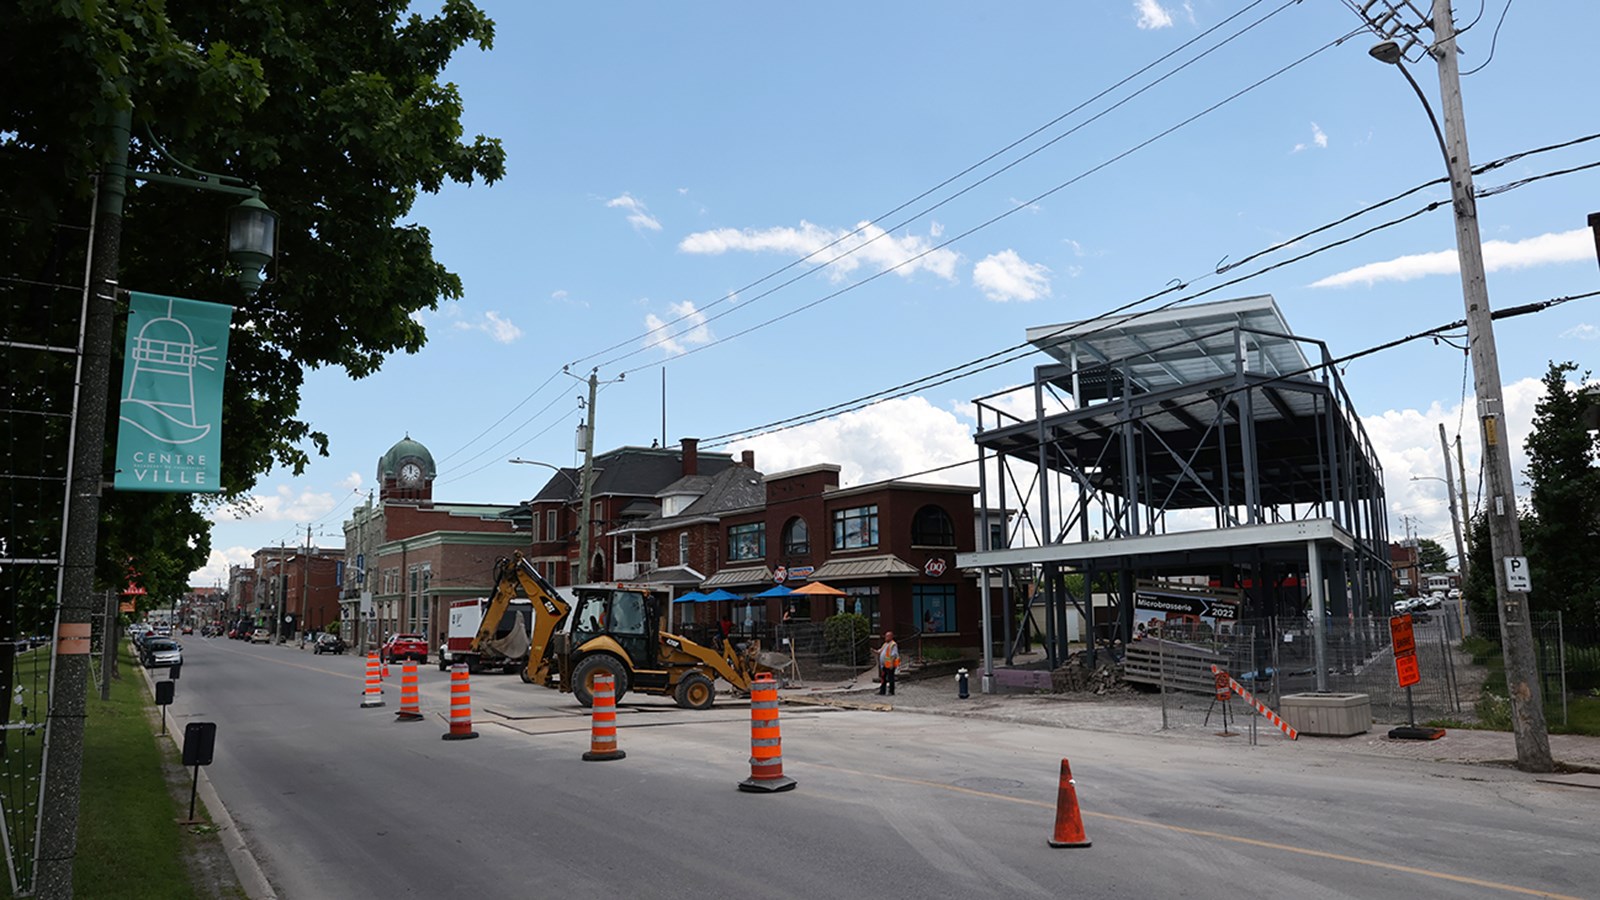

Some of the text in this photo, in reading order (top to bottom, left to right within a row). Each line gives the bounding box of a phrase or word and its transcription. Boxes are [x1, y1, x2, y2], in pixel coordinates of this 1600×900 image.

[133, 451, 206, 465] CENTRE
[133, 469, 206, 484] VILLE
[1511, 559, 1521, 572] P
[1137, 599, 1192, 612] Microbrasserie
[1212, 608, 1235, 618] 2022
